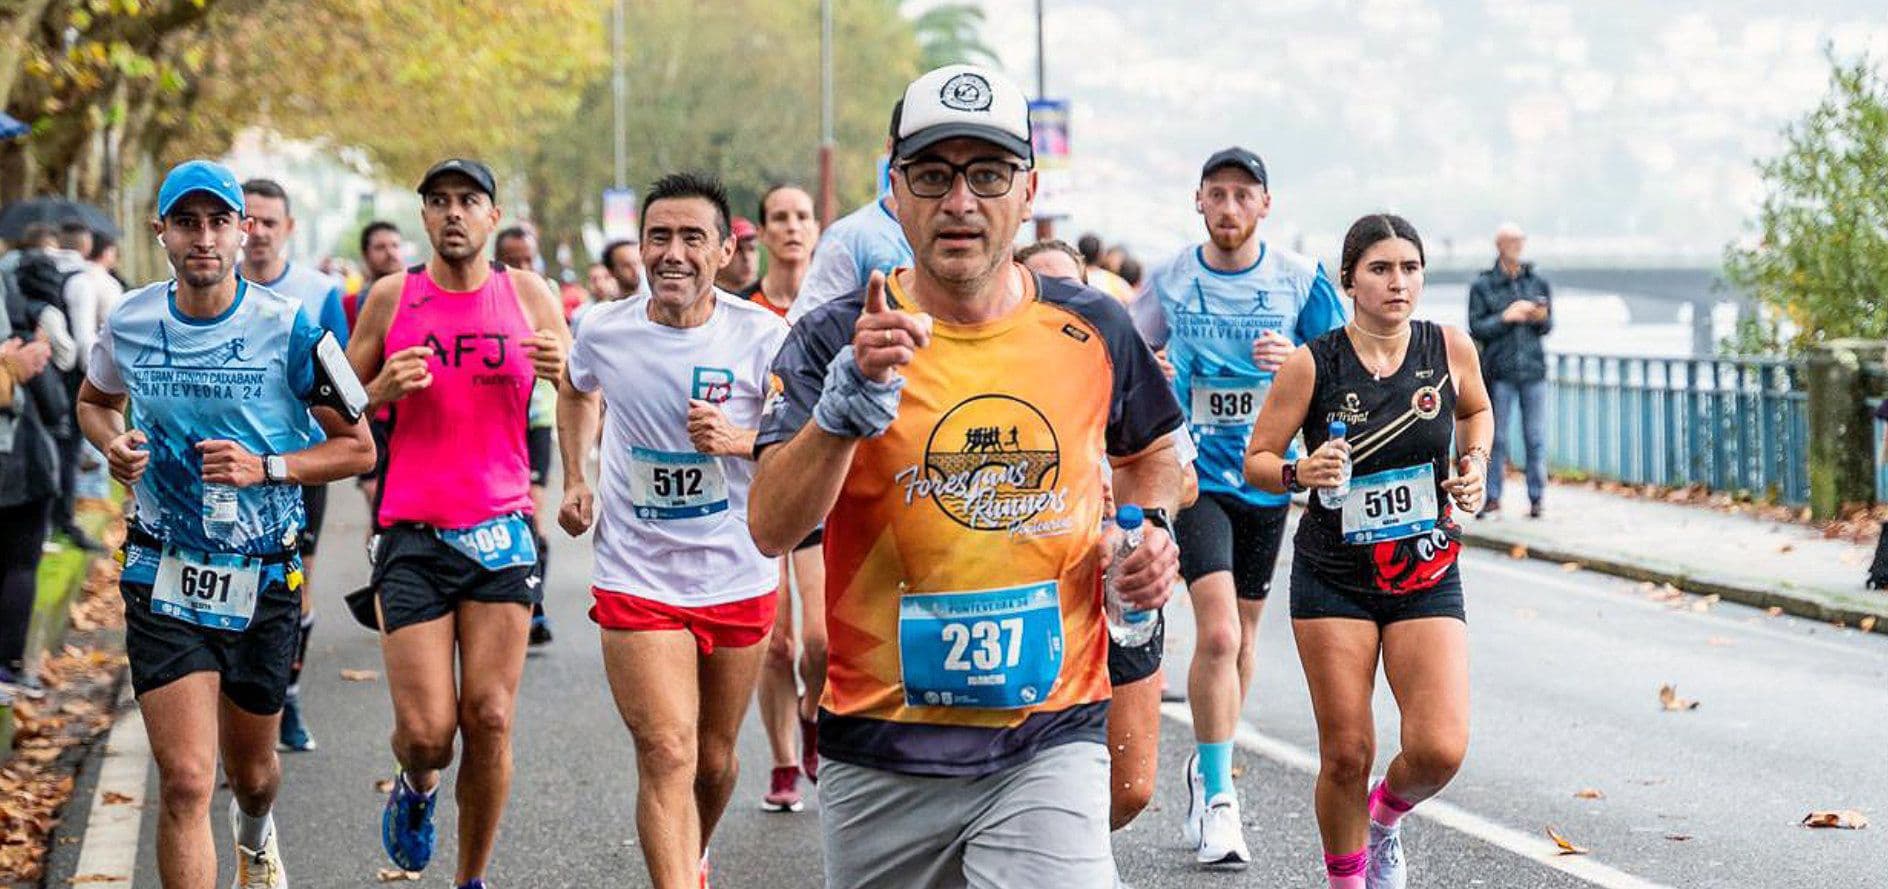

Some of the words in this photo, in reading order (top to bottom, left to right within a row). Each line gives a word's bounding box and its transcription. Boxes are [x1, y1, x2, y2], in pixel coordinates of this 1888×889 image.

[423, 332, 508, 369] AFJ
[243, 386, 262, 399] 24
[1210, 392, 1253, 417] 938
[654, 468, 703, 497] 512
[970, 486, 1069, 529] Runners
[1365, 485, 1412, 518] 519
[181, 566, 231, 603] 691
[942, 617, 1024, 671] 237
